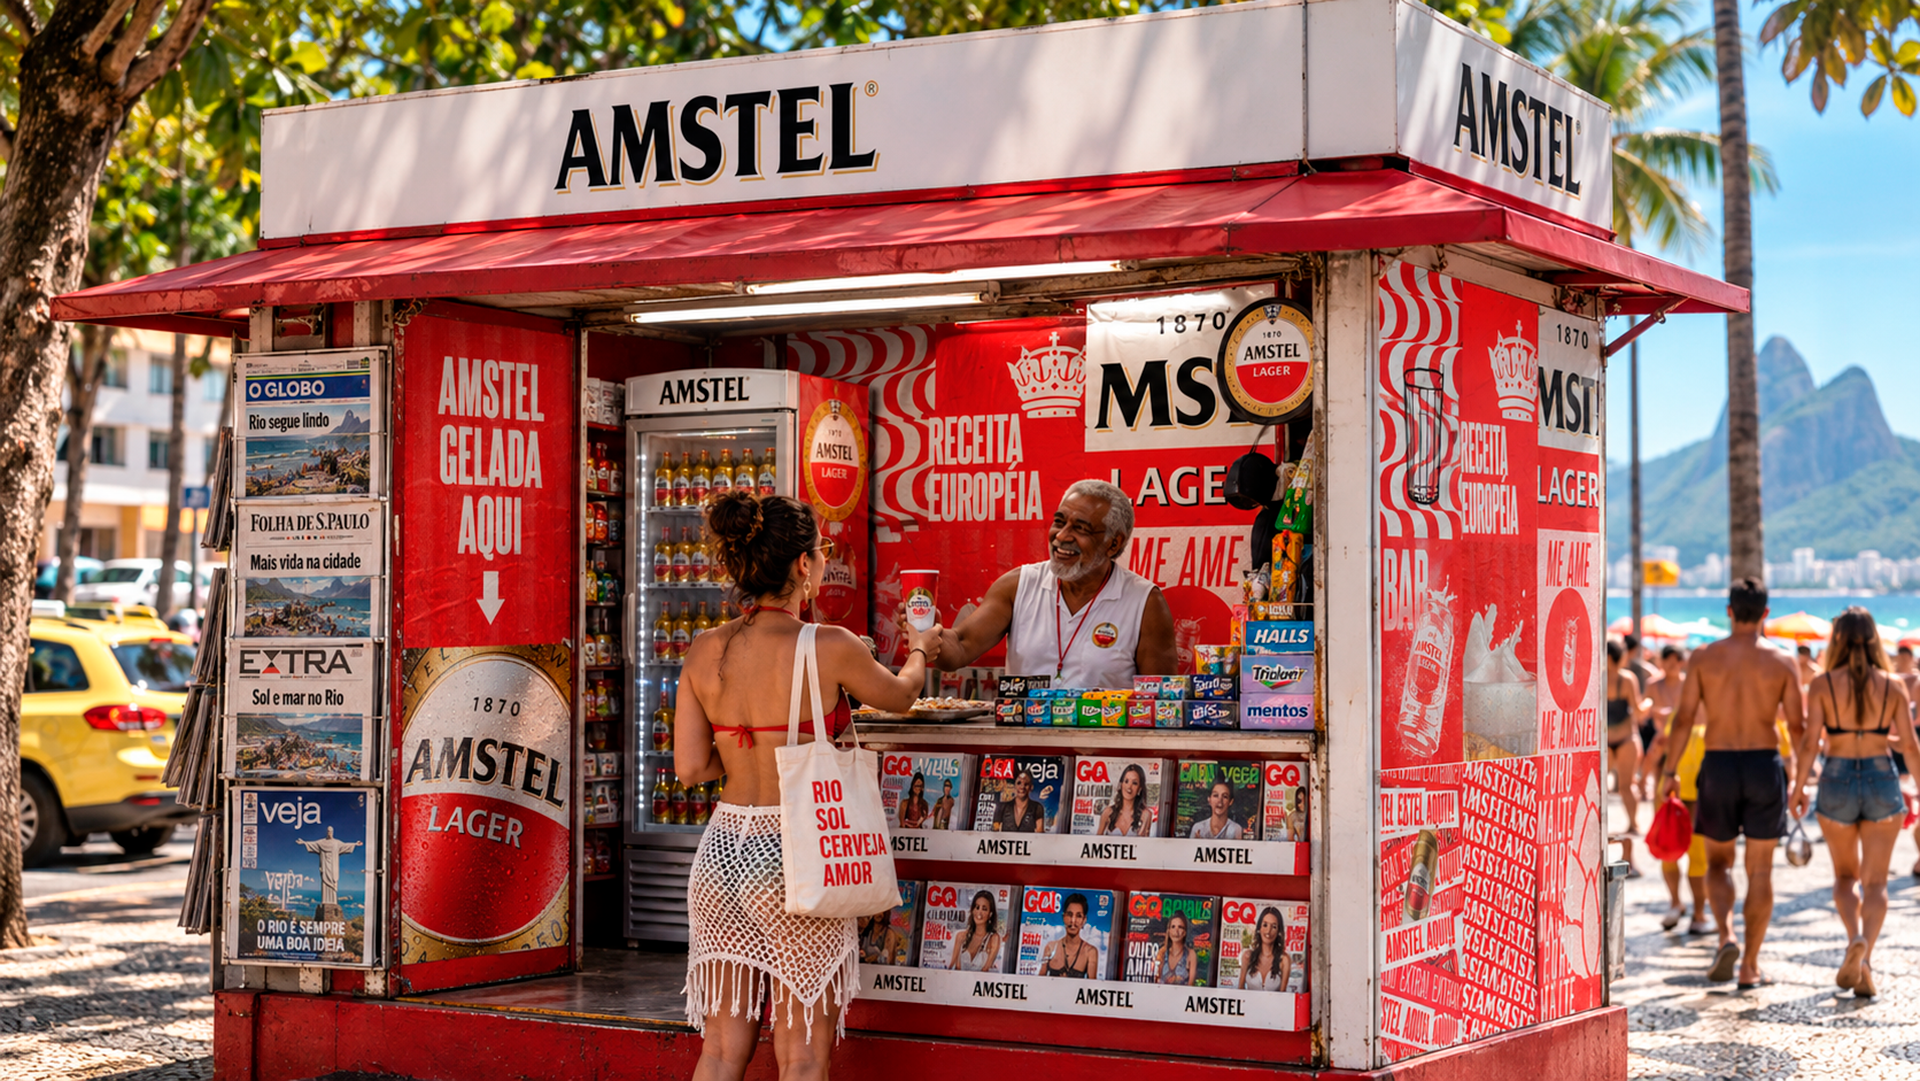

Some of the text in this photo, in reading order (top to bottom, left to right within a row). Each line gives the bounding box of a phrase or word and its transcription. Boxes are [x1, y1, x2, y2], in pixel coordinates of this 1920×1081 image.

[1156, 311, 1227, 335] 1870
[1556, 323, 1589, 349] 1870
[1244, 343, 1301, 361] AMSTEL
[1253, 365, 1291, 378] LAGER
[249, 380, 325, 398] O GLOBO
[437, 356, 545, 422] AMSTEL
[659, 376, 750, 406] AMSTEL
[249, 412, 330, 432] Rio segue lindo
[816, 441, 853, 461] AMSTEL
[928, 413, 1024, 466] RECEITA
[1460, 420, 1508, 476] RECEITA
[439, 424, 543, 489] GELADA
[821, 466, 848, 480] LAGER
[928, 457, 1045, 523] EUROPÉIA
[1537, 465, 1599, 509] LAGER
[1461, 475, 1520, 536] EUROPÉIA
[251, 512, 370, 532] FOLHA DE S.PAULO
[457, 495, 522, 561] AQUI
[250, 552, 361, 570] Mais vida na cidade
[1128, 535, 1245, 588] ME AME
[1545, 540, 1592, 588] ME AME
[1254, 629, 1310, 644] HALLS
[239, 649, 352, 674] EXTRA
[252, 688, 344, 706] Sol e mar no Rio
[473, 696, 521, 717] 1870
[1247, 703, 1309, 718] mentos
[1541, 708, 1598, 750] ME AMSTEL
[403, 736, 566, 811] AMSTEL
[883, 755, 914, 777] GQ
[1017, 758, 1059, 783] veja
[1265, 763, 1301, 787] GQ
[1542, 753, 1574, 796] PURO
[811, 779, 843, 804] RIO
[260, 796, 322, 830] veja
[815, 806, 851, 831] SOL
[1539, 797, 1574, 845] MALTE
[427, 805, 525, 849] LAGER
[819, 833, 888, 859] CERVEJA
[890, 837, 928, 853] MSTEL
[977, 839, 1031, 856] AMSTEL
[1080, 842, 1137, 861] AMSTEL
[1194, 847, 1253, 865] AMSTEL
[823, 861, 873, 887] AMOR
[927, 885, 957, 908] GQ
[1222, 900, 1257, 925] GQ
[257, 918, 266, 934] O
[268, 920, 287, 934] RIO
[300, 920, 346, 935] SEMPRE
[257, 935, 284, 950] UMA
[286, 936, 311, 951] BOA
[1385, 924, 1425, 965] AMSTEL
[873, 974, 926, 993] AMSTEL
[972, 981, 1028, 1000] AMSTEL
[1075, 987, 1133, 1008] AMSTEL
[1184, 995, 1245, 1016] AMSTEL
